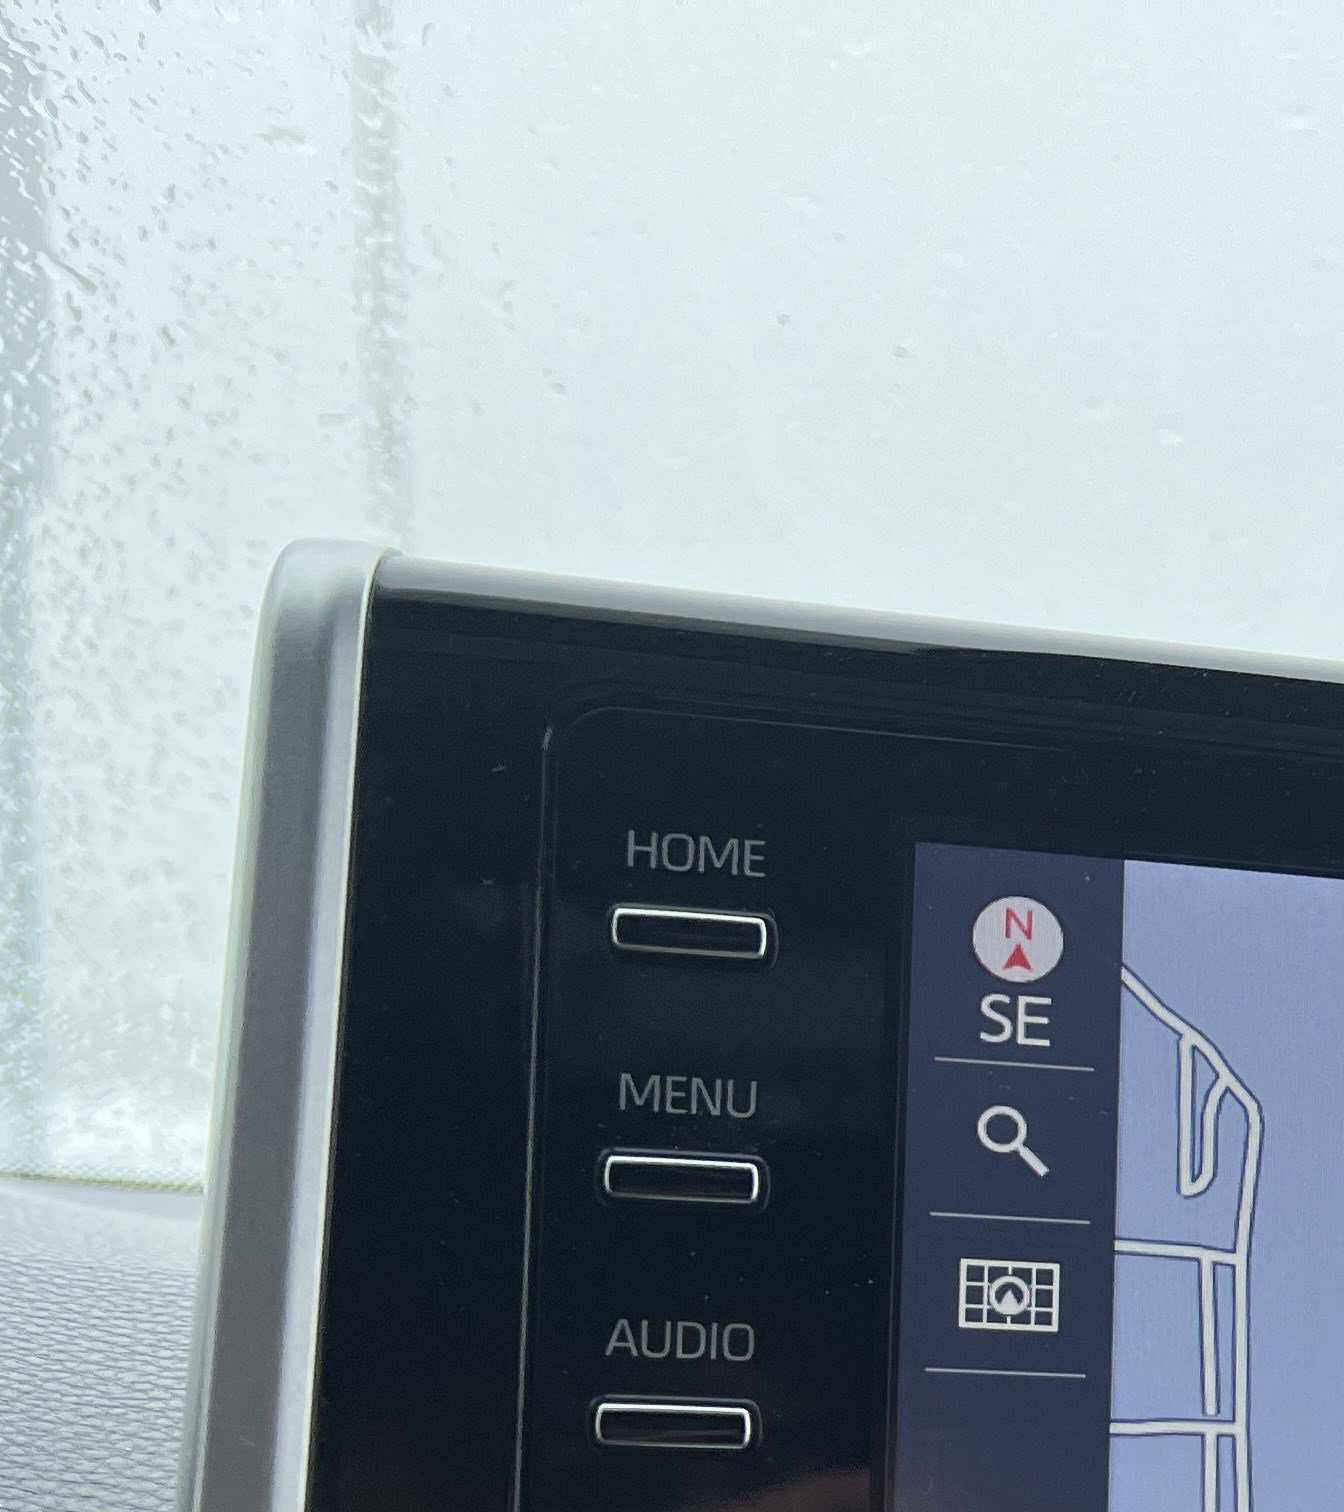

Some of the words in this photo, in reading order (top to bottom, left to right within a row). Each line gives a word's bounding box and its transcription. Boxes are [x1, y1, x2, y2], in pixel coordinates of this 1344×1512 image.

[626, 829, 767, 878] HOME
[1003, 906, 1033, 941] N
[979, 992, 1052, 1047] SE
[618, 1072, 758, 1119] MENU
[604, 1318, 756, 1362] AUDIO
